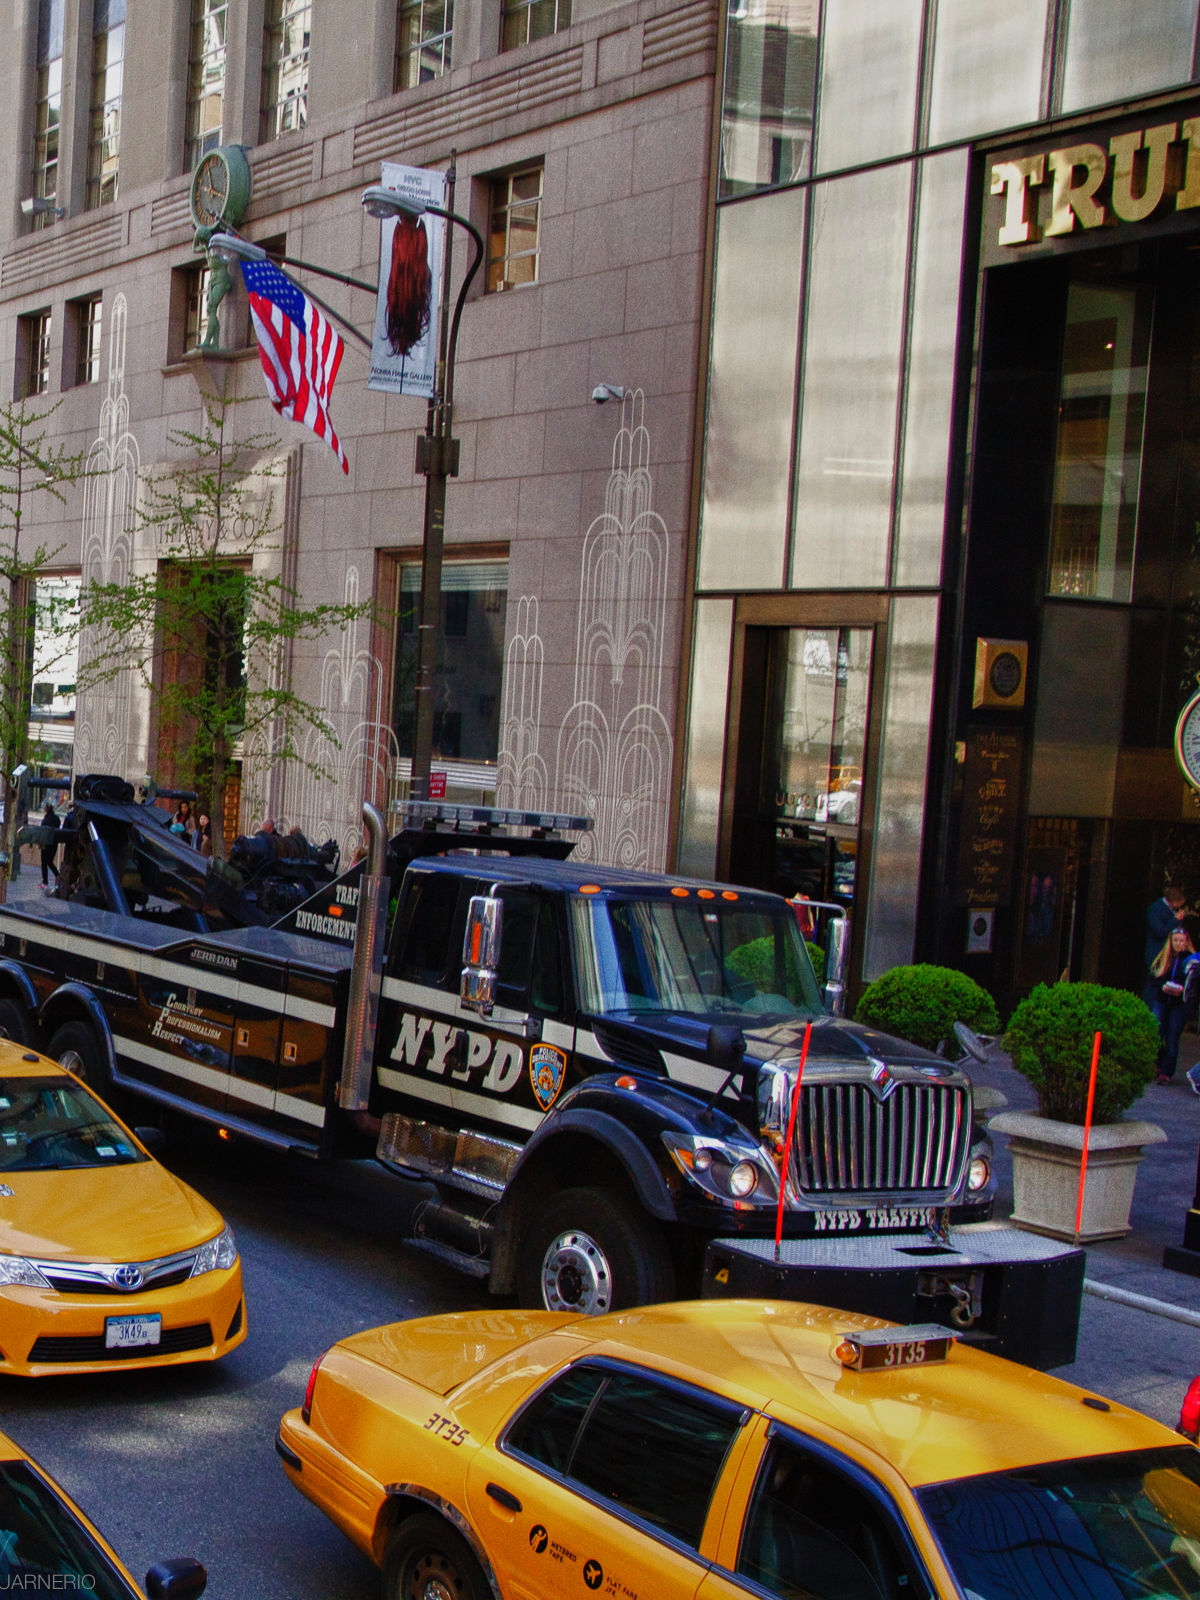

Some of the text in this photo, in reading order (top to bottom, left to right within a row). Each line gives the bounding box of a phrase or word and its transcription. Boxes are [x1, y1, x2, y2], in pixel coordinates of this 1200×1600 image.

[296, 910, 358, 941] ENFORCEMENT
[151, 1021, 185, 1044] RESPECT
[158, 1006, 221, 1040] PROFESSIONALISM
[390, 1012, 524, 1093] NYPD
[814, 1209, 861, 1231] NYPD
[884, 1340, 927, 1367] 3T35
[423, 1412, 470, 1447] 3T35
[551, 1540, 578, 1562] METERED
